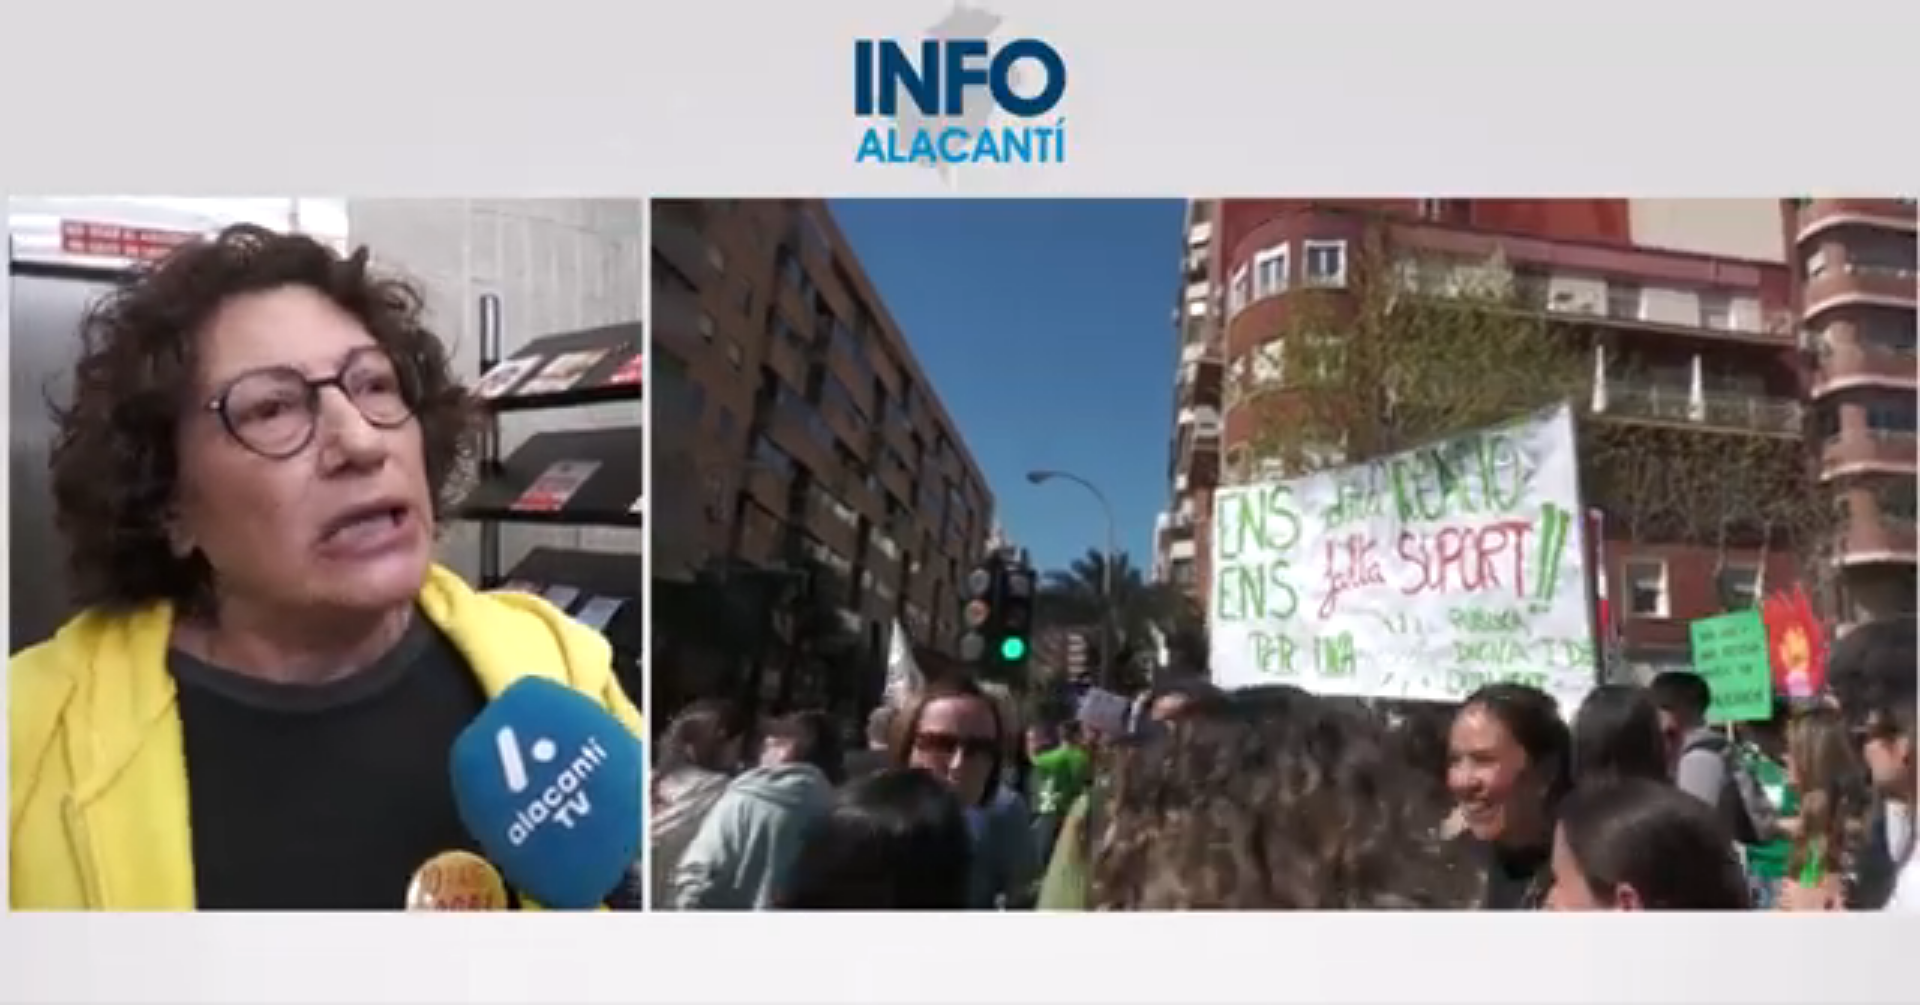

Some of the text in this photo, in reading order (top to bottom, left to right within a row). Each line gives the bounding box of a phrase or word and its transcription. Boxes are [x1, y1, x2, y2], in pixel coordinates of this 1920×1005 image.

[1218, 484, 1301, 561] ENS
[1218, 559, 1298, 620] ENS
[553, 790, 591, 828] TV
